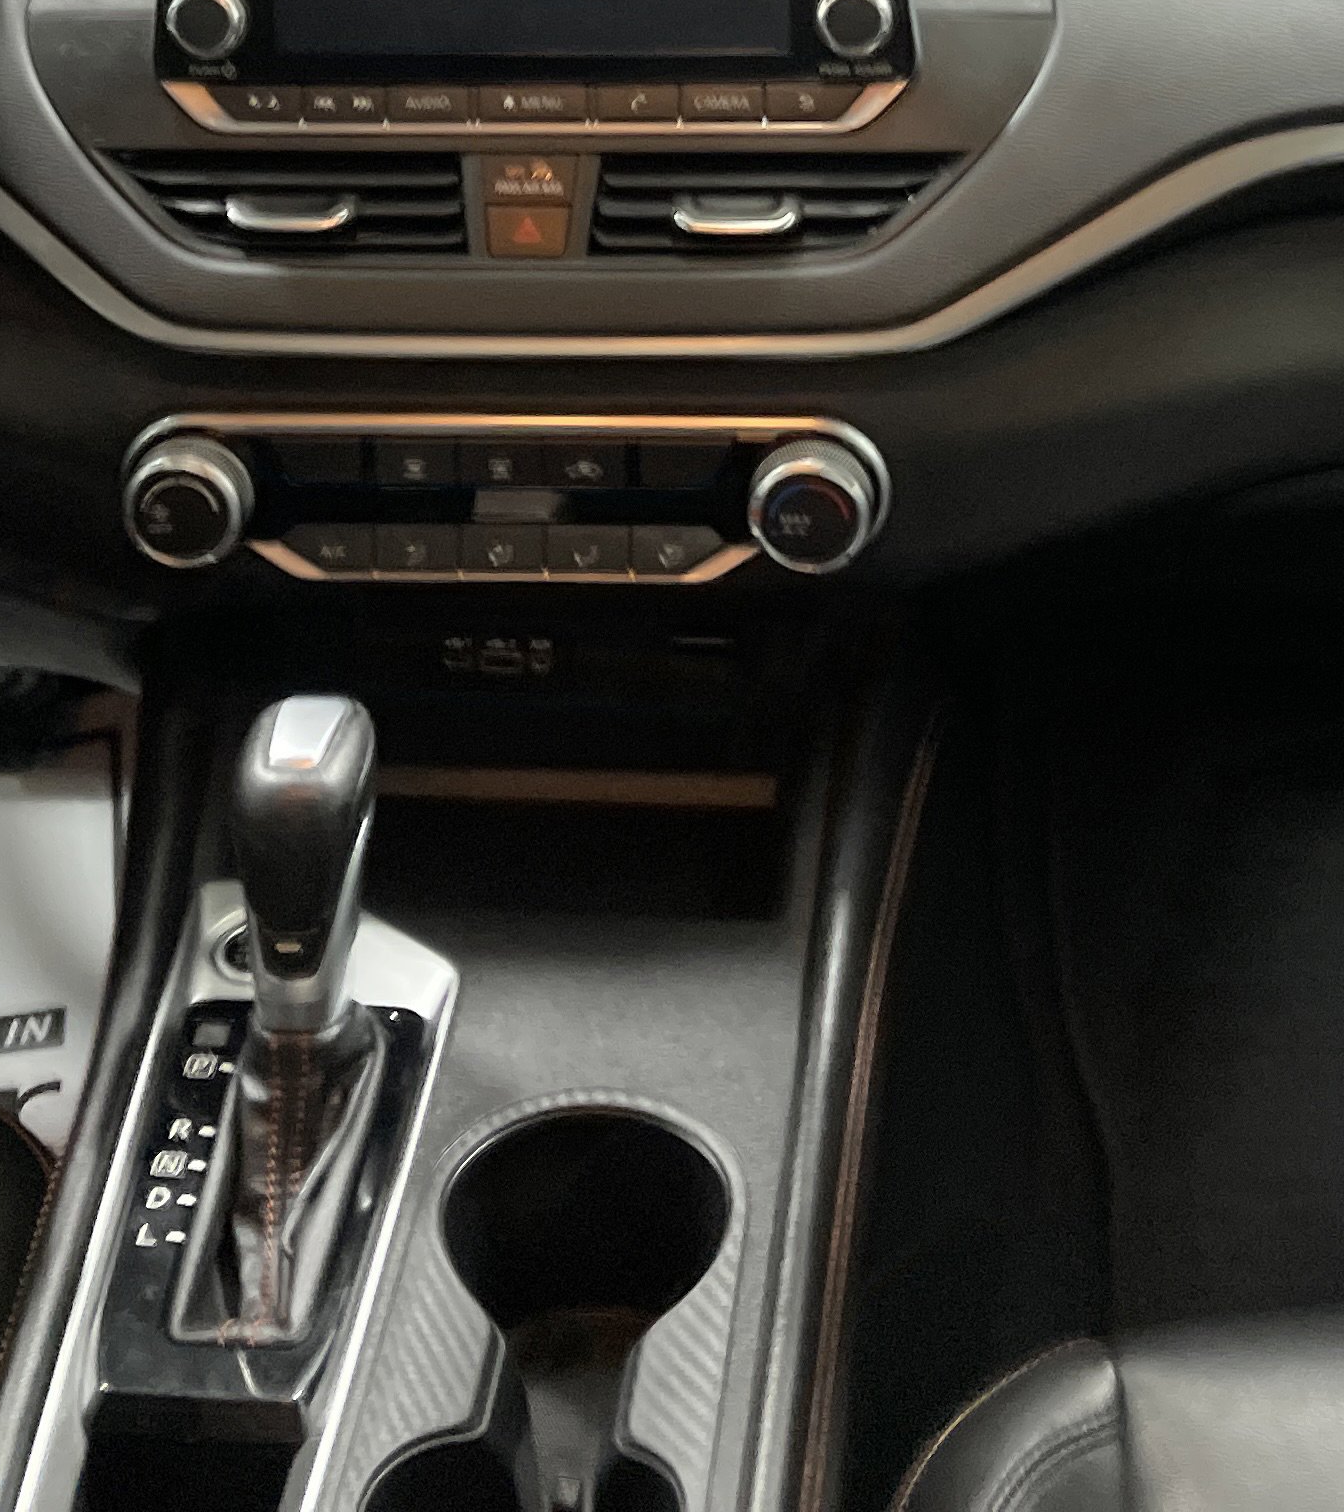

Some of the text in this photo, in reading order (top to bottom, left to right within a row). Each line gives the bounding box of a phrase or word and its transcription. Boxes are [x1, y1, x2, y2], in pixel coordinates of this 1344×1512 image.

[3, 1013, 53, 1049] IN
[168, 1117, 193, 1140] R
[145, 1186, 172, 1210] D
[135, 1223, 157, 1247] L
